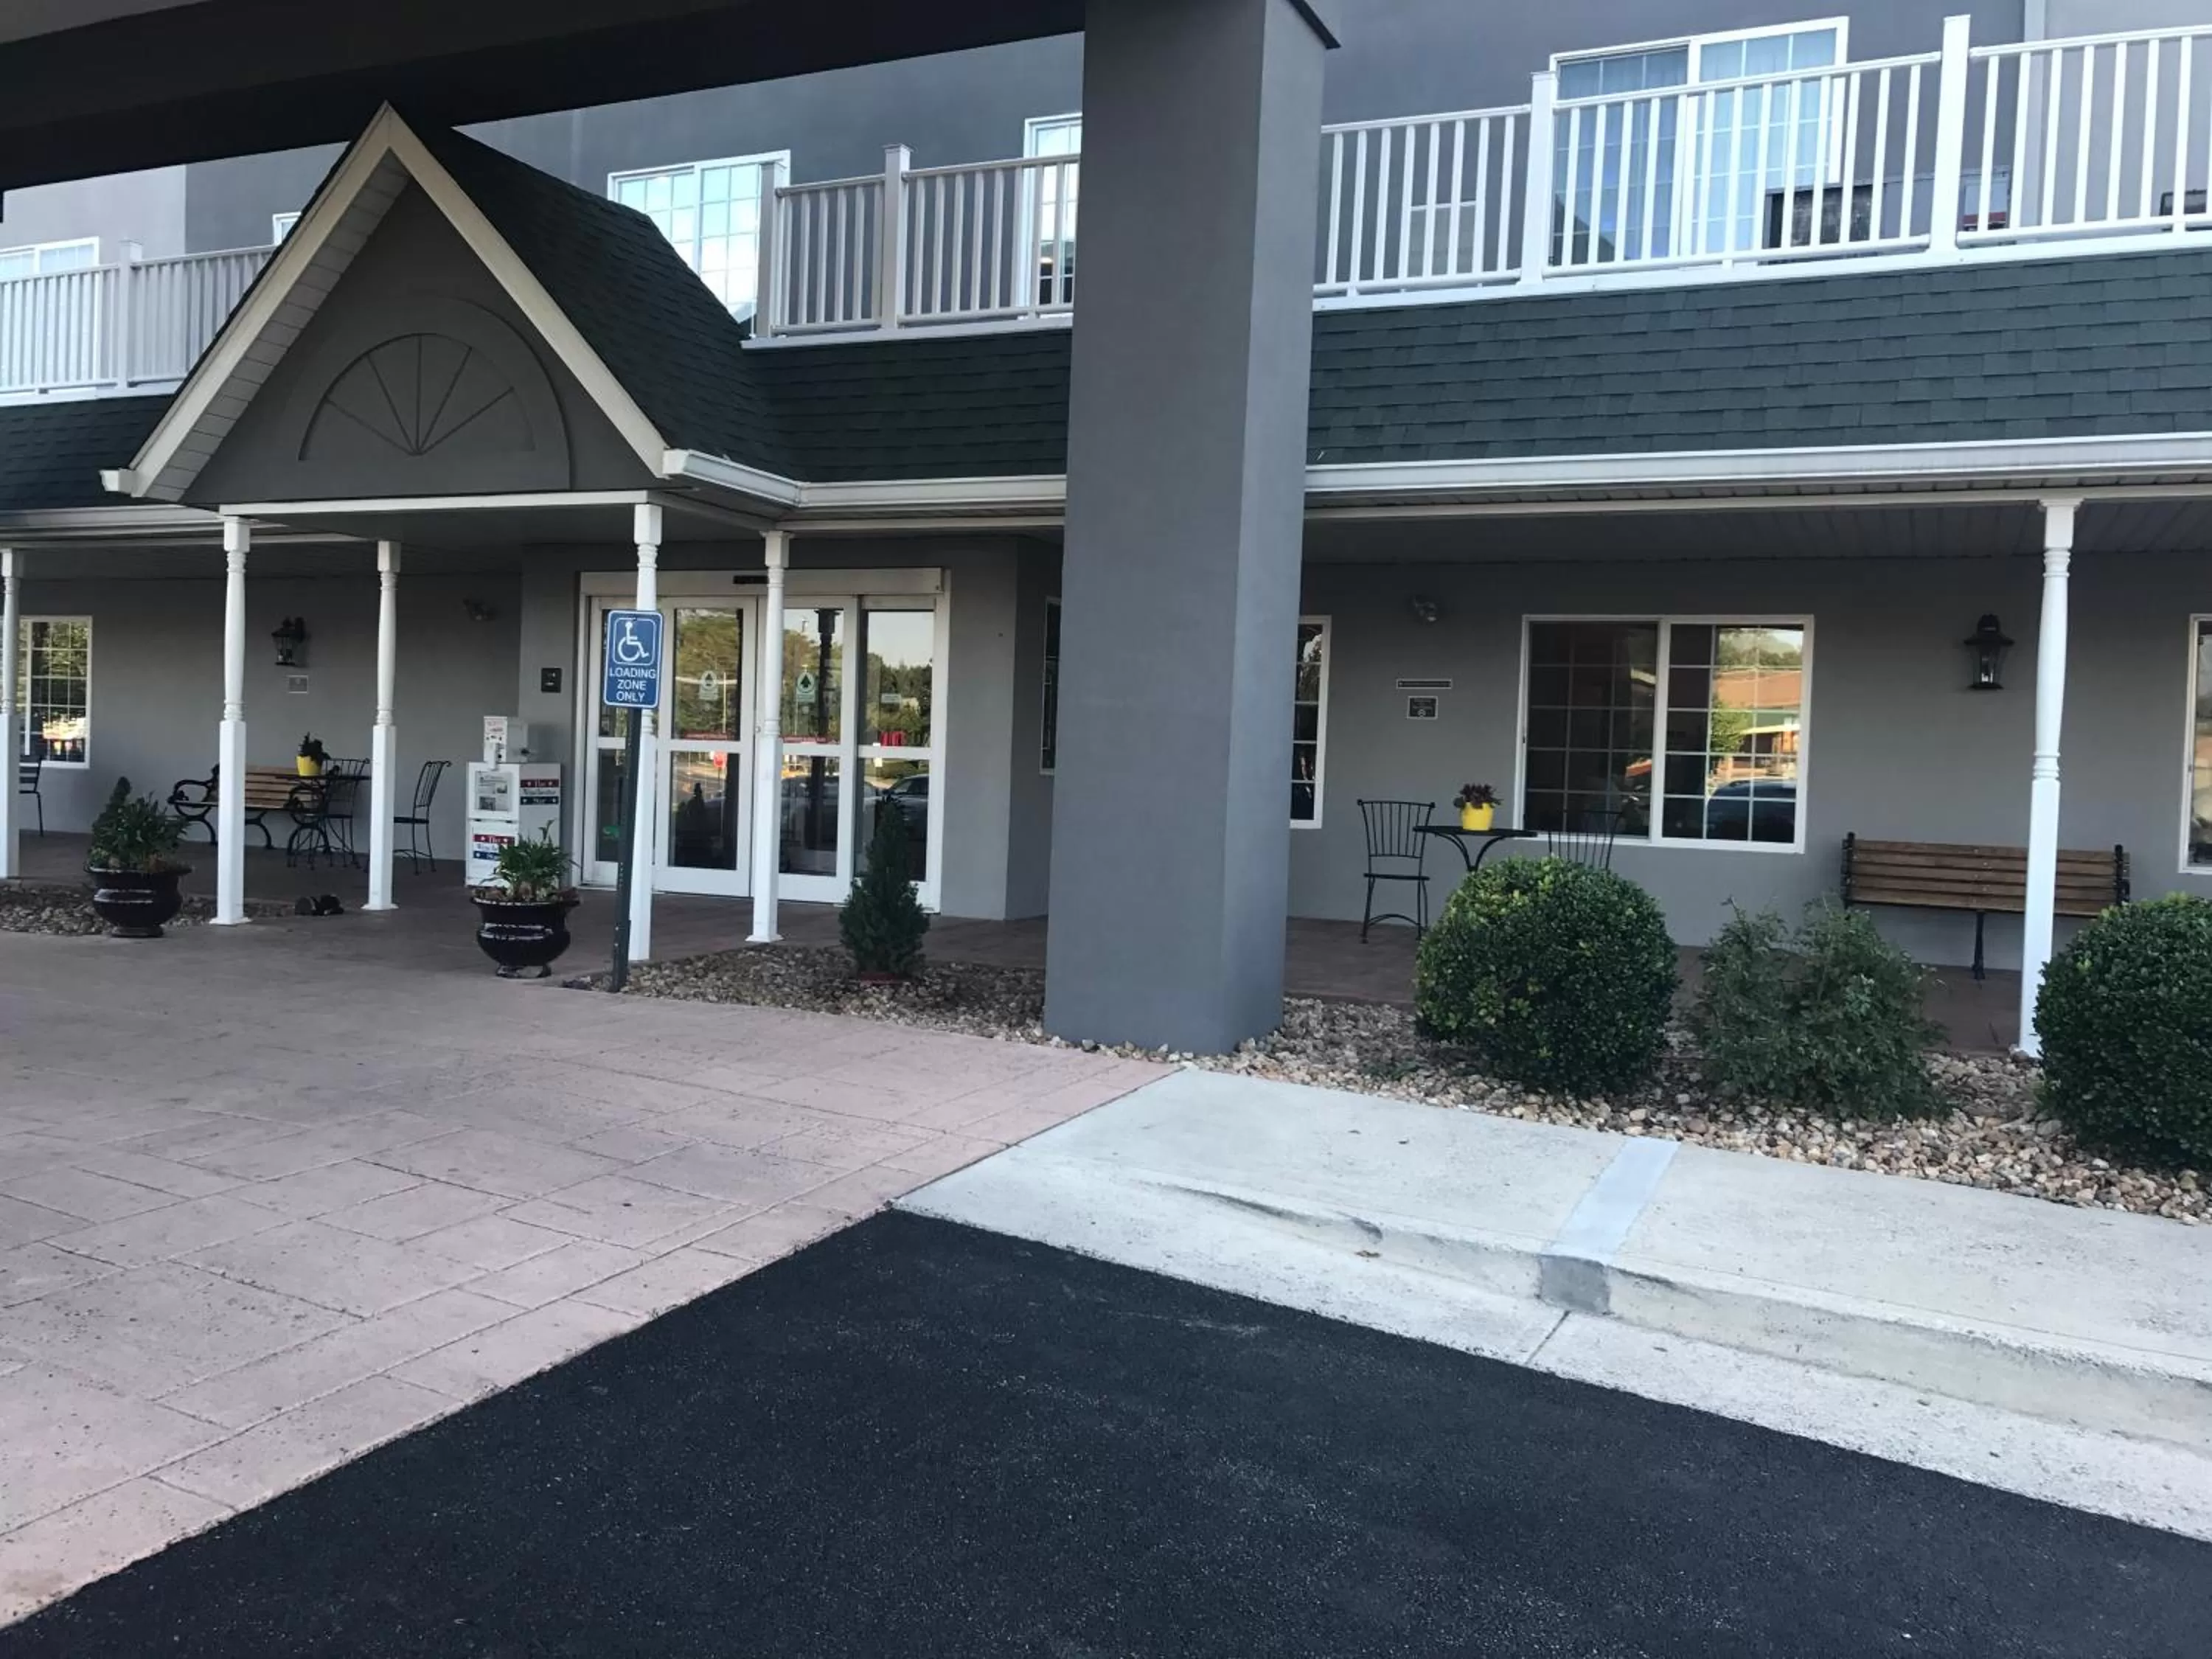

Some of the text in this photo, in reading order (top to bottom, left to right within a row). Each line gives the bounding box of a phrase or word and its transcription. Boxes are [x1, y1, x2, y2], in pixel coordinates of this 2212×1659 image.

[609, 667, 656, 678] LOADING
[617, 679, 647, 690] ZONE
[616, 691, 645, 702] ONLY
